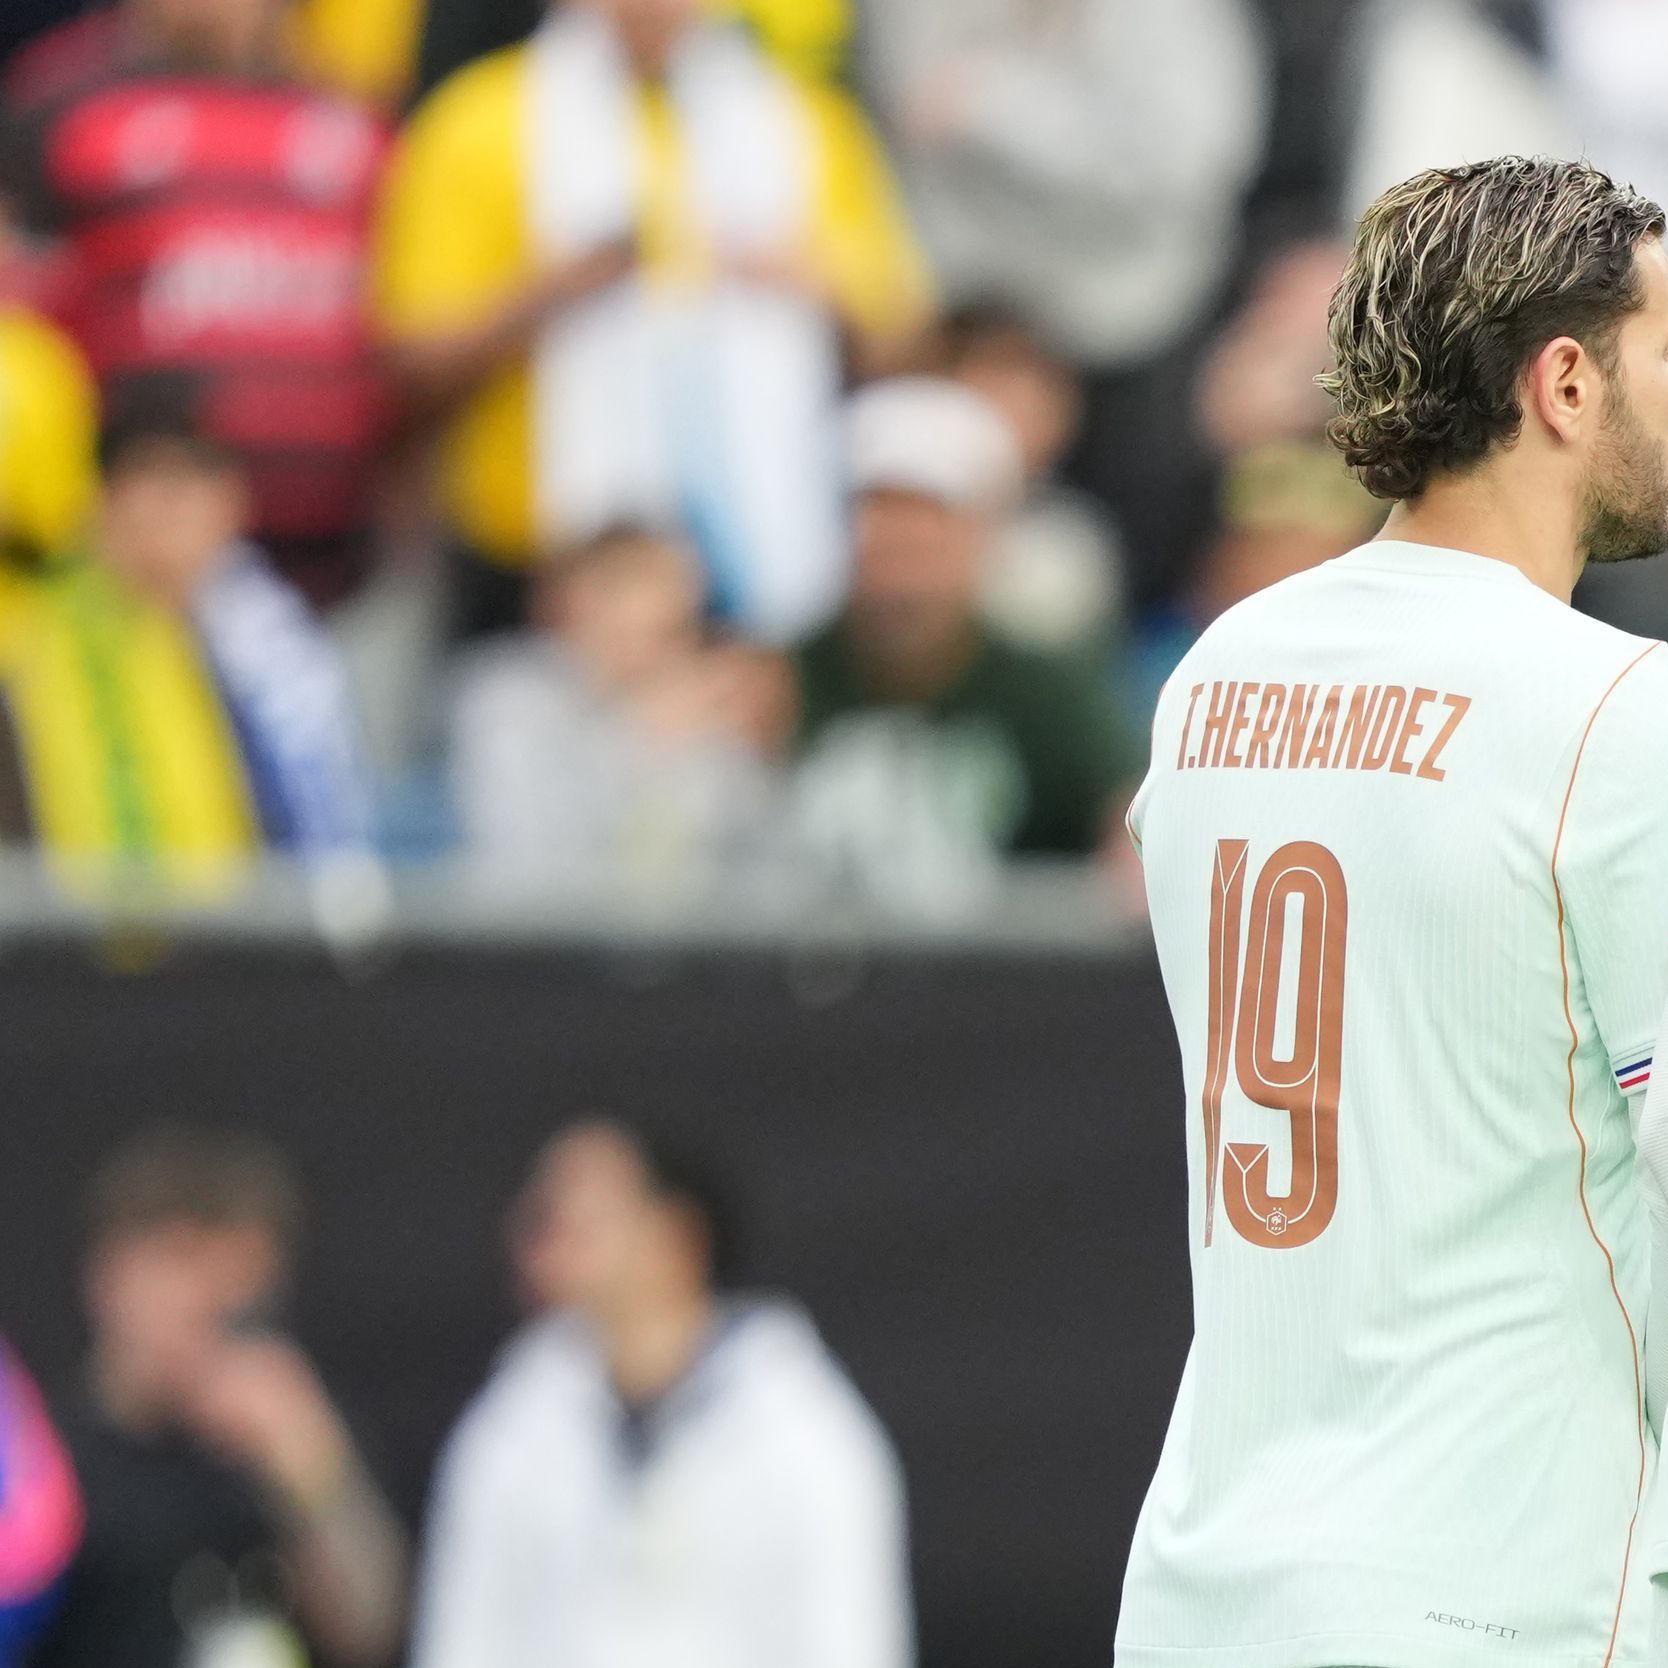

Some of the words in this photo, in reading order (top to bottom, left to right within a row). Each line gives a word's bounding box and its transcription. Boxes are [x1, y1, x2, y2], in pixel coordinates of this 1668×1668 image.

[1176, 681, 1471, 783] T.HERNANDEZ
[1203, 839, 1348, 1249] 19
[1424, 1610, 1520, 1640] AERO-FIT
